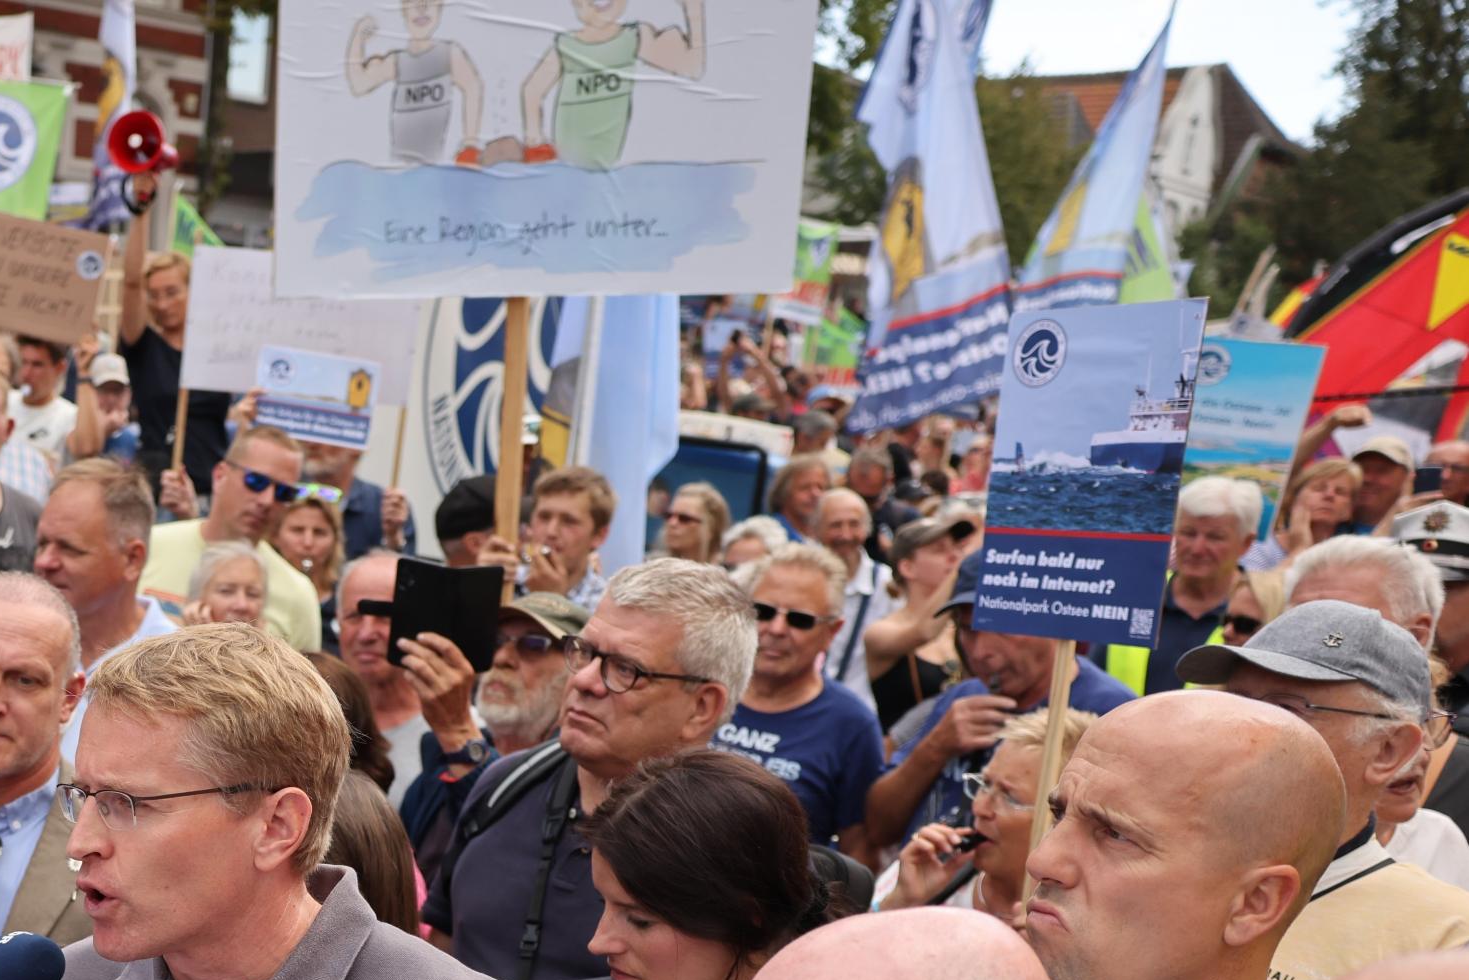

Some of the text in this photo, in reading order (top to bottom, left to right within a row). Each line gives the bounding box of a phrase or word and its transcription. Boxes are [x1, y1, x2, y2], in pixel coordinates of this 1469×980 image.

[404, 83, 445, 104] NPO
[577, 72, 622, 96] NPO
[384, 219, 427, 244] Eine
[518, 212, 576, 255] geht
[986, 548, 1104, 571] Surfen bald nur
[983, 571, 1116, 595] noch im Internet?
[978, 594, 1130, 621] Nationalpark Ostsee NEIN
[717, 723, 781, 754] GANZ
